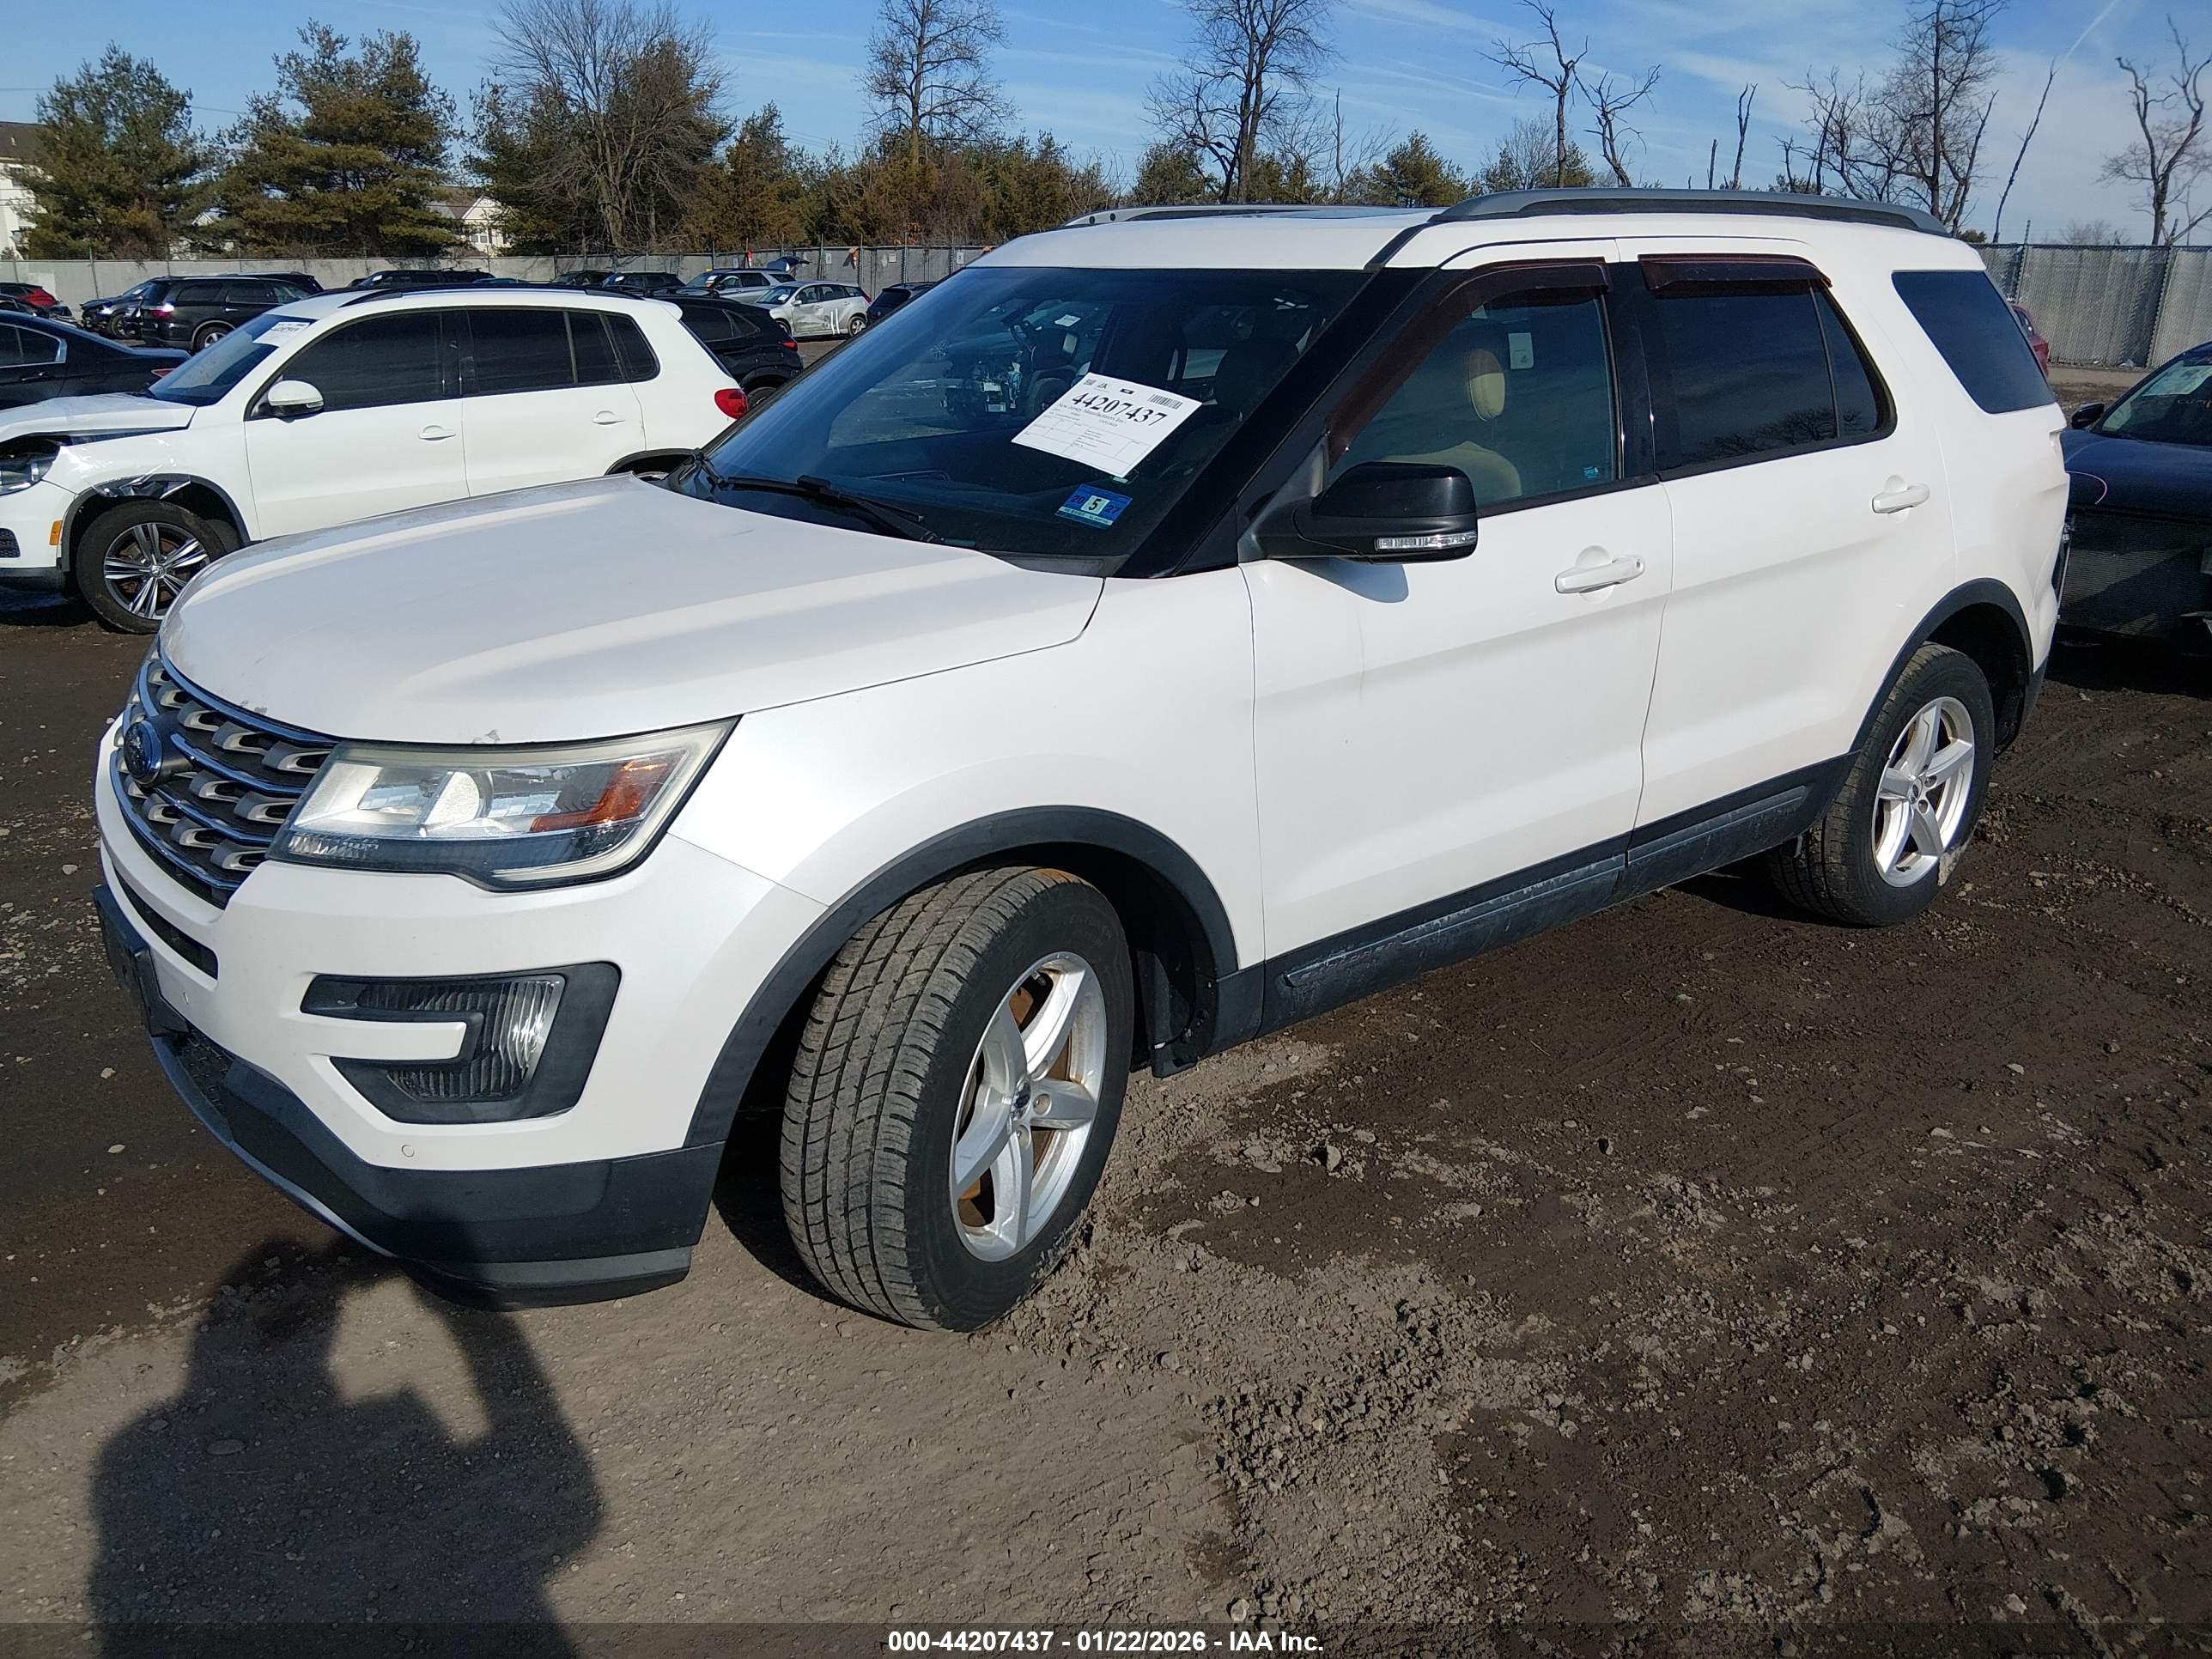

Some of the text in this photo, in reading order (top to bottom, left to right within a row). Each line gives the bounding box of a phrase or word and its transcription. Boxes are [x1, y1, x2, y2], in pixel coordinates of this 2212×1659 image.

[1072, 392, 1168, 427] 44207437
[1070, 495, 1121, 514] 20 5 27
